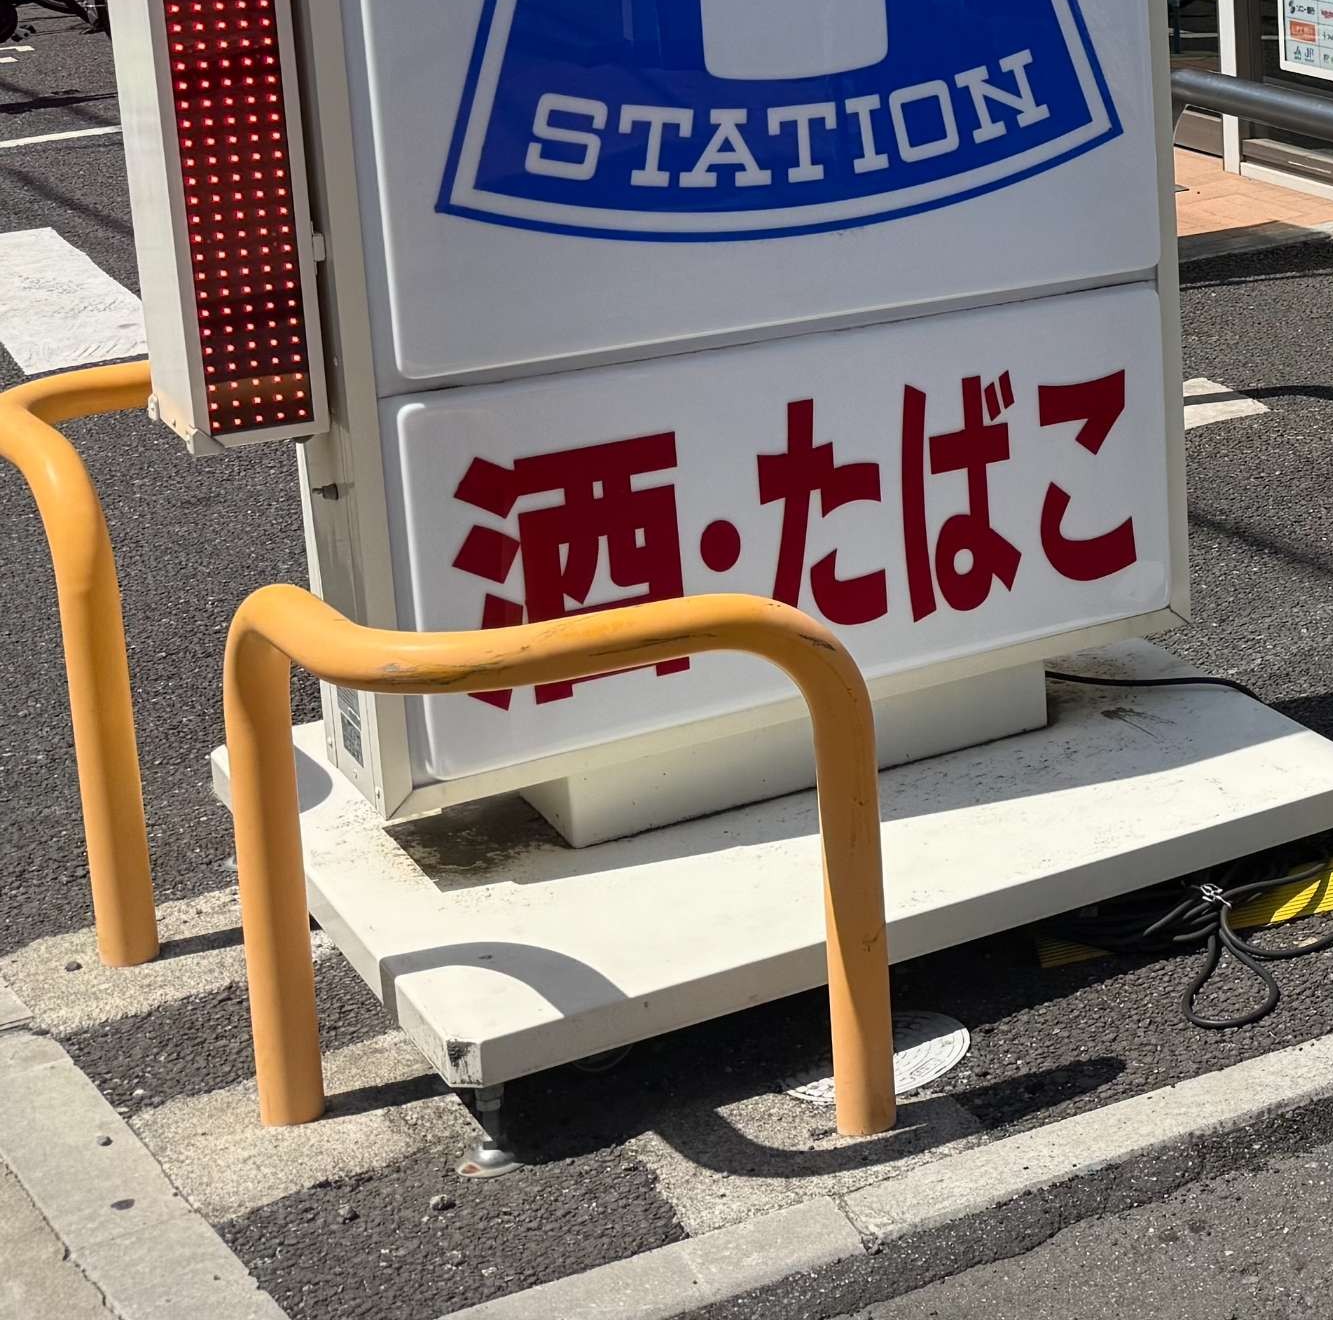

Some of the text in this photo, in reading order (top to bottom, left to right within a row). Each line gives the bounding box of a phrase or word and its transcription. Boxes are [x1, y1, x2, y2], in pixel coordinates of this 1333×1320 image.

[523, 50, 1053, 189] STATION
[453, 370, 1137, 710] 酒・たばこ
